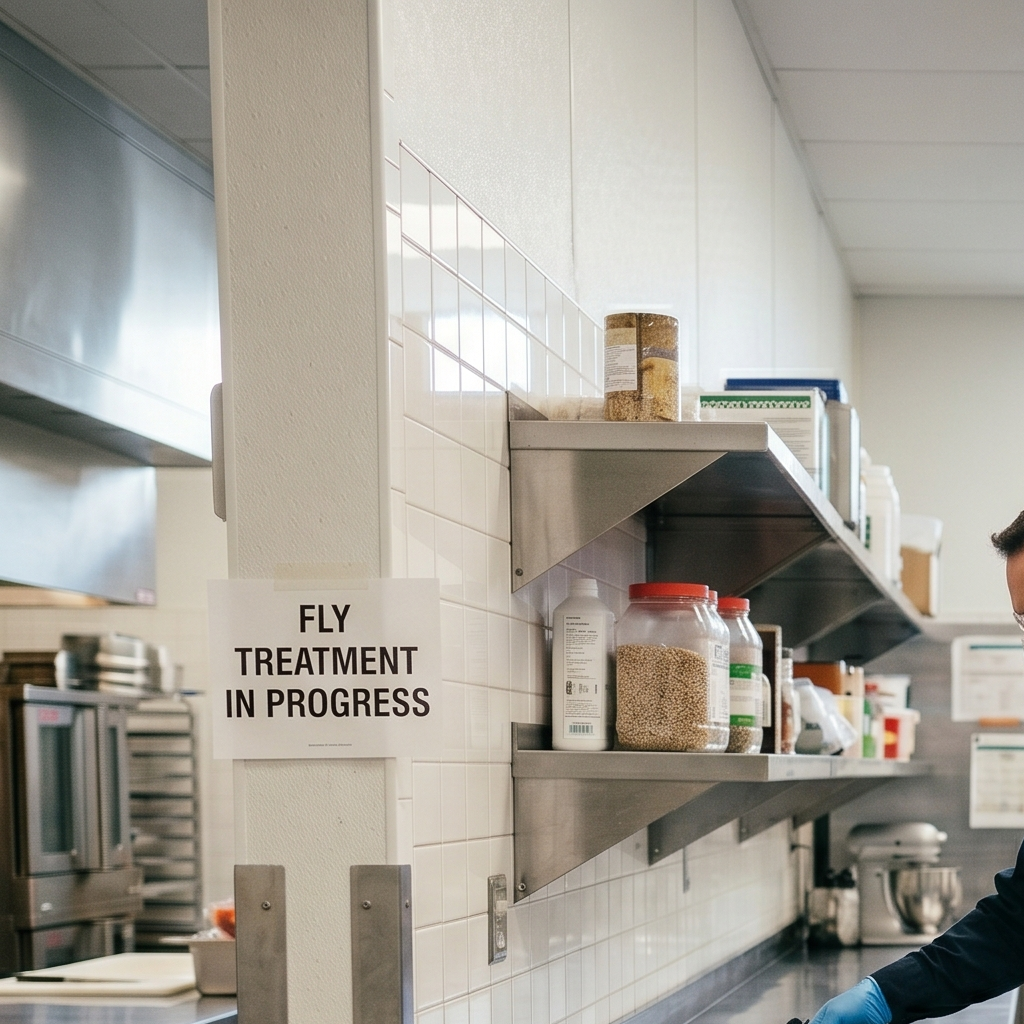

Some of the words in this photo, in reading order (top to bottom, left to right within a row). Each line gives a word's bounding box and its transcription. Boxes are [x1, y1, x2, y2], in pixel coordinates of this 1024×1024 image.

[299, 604, 351, 633] FLY
[234, 646, 418, 676] TREATMENT
[226, 689, 255, 718] IN
[266, 687, 430, 718] PROGRESS
